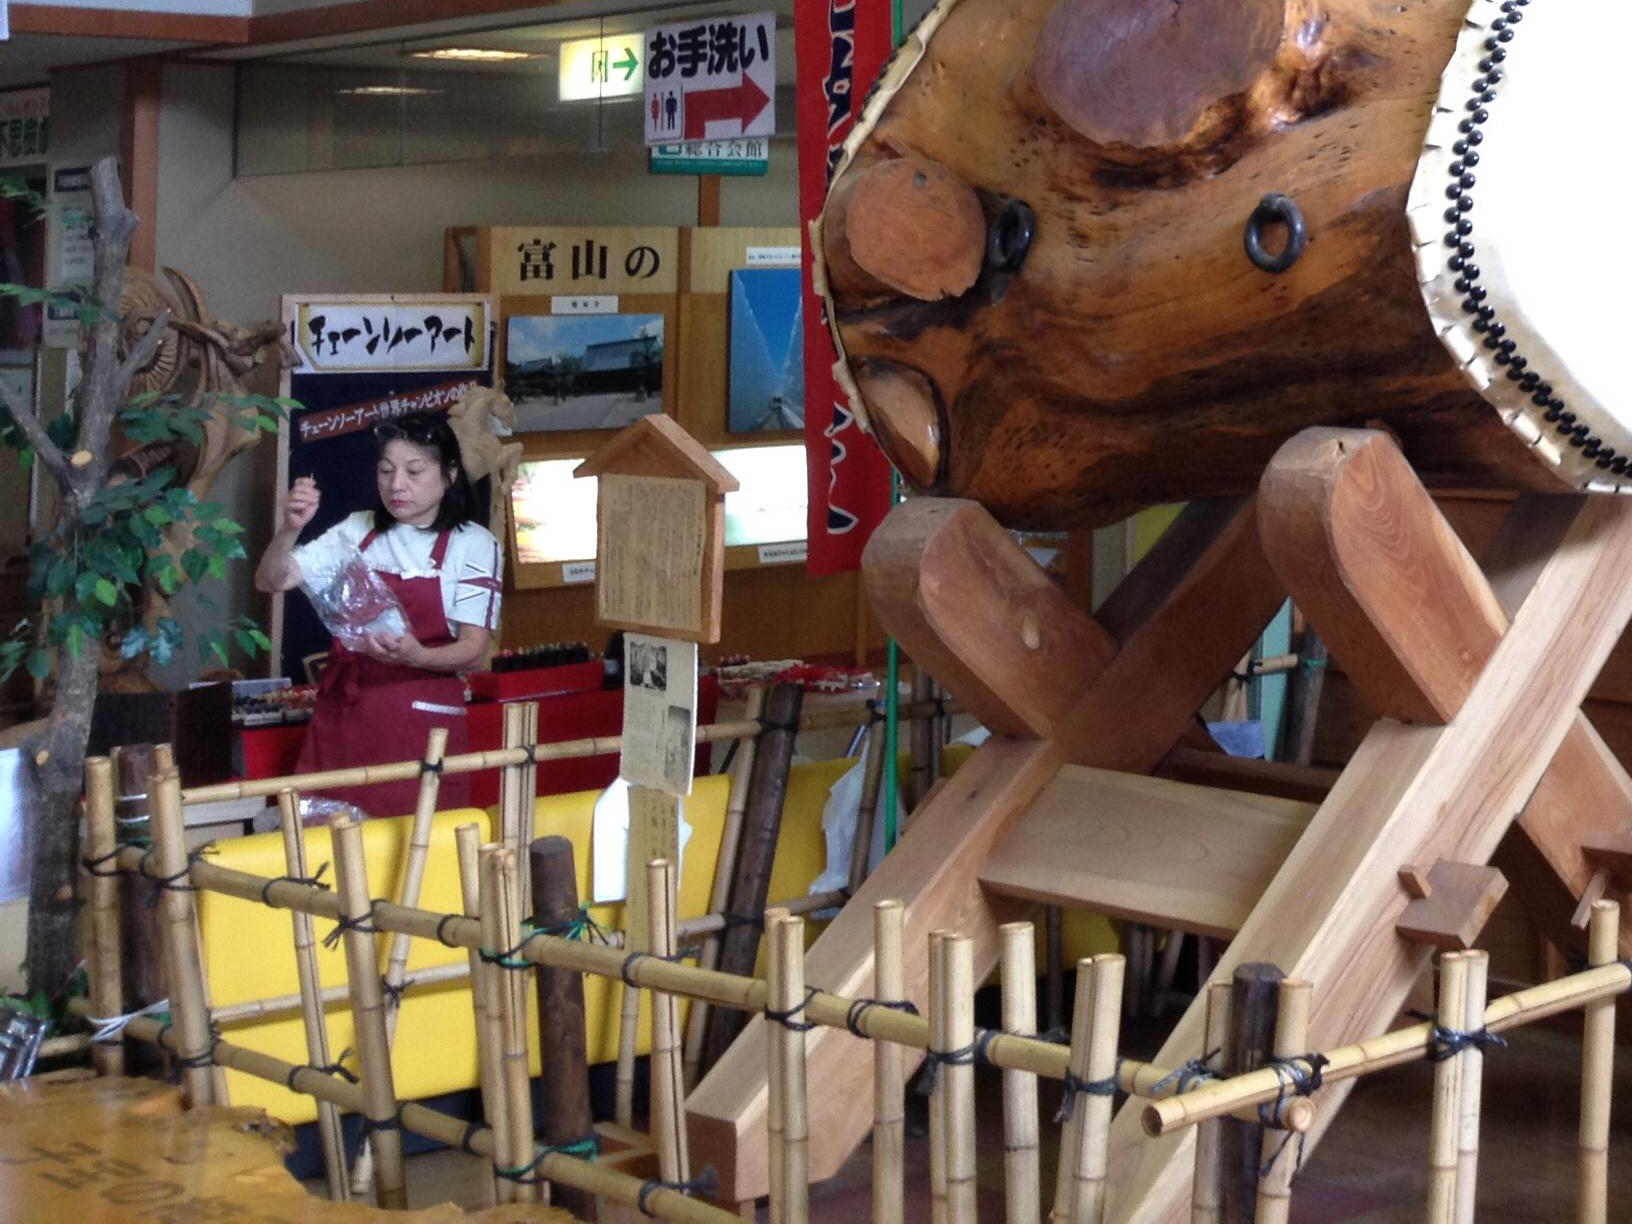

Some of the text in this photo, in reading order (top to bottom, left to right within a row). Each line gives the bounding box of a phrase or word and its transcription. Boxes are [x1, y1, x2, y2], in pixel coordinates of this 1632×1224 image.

[648, 21, 770, 80] お手洗い
[517, 238, 661, 281] 富山の
[308, 314, 475, 357] チェーンソーアート
